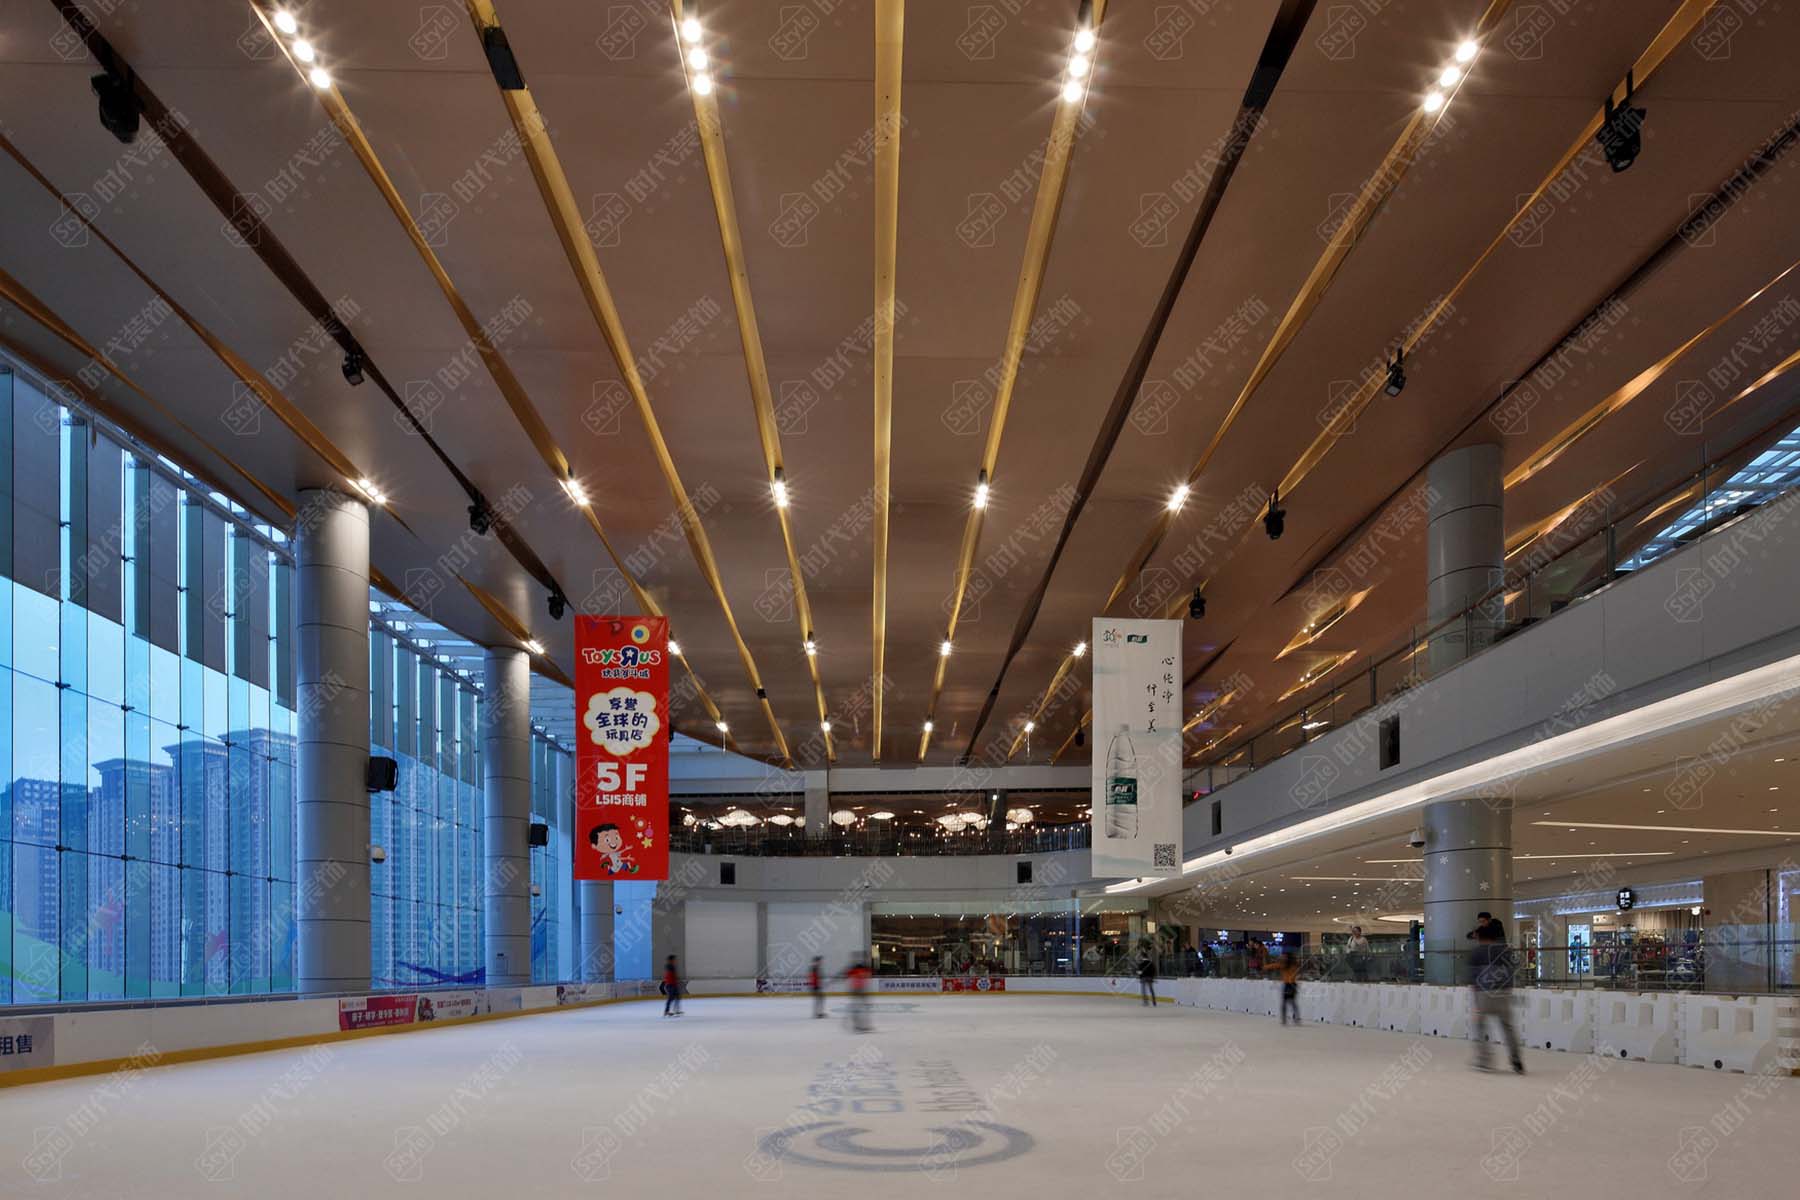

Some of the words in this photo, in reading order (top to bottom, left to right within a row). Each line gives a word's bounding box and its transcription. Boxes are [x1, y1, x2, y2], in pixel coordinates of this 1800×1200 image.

[609, 697, 638, 711] 享誉
[596, 712, 648, 728] 全球的
[606, 729, 643, 741] 玩具店
